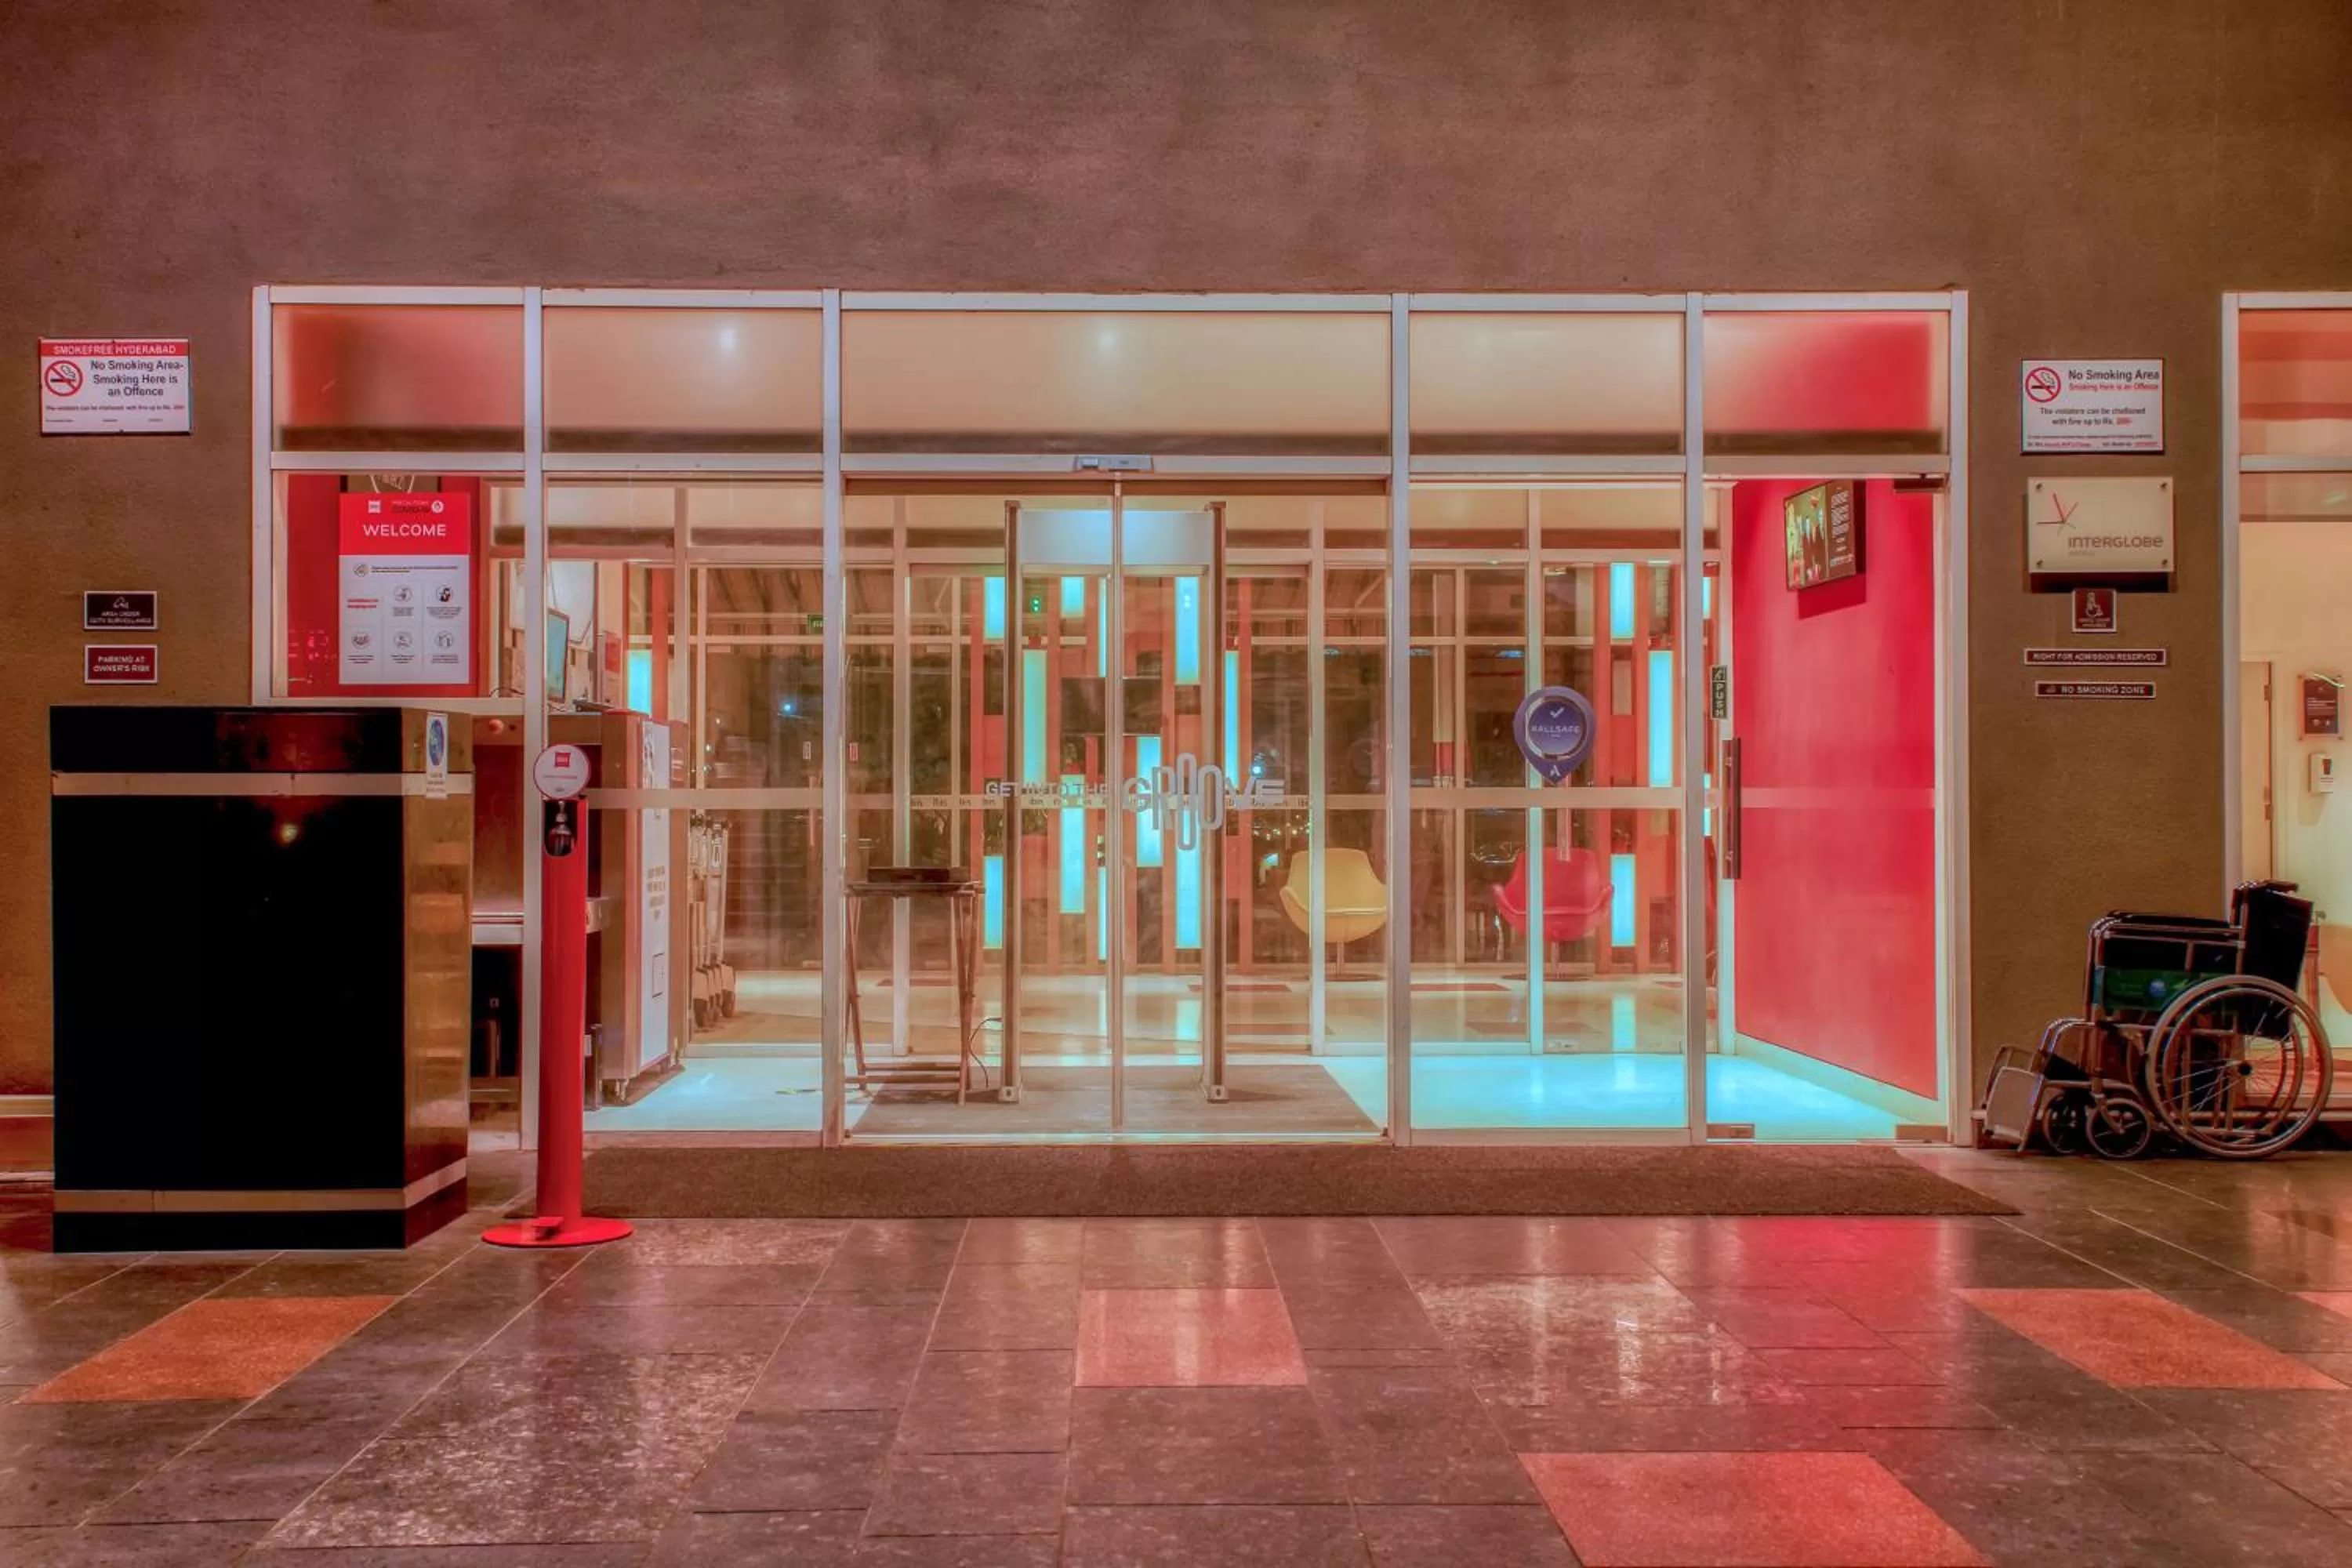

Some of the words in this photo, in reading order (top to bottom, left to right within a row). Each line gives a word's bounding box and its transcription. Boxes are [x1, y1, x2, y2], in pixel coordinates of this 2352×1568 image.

[53, 345, 114, 355] SMOKEFREE
[115, 345, 176, 354] HYDERABAD
[90, 361, 106, 371] No
[108, 360, 154, 372] Smoking
[93, 374, 139, 386] Smoking
[141, 374, 165, 383] Here
[169, 374, 179, 383] is
[2068, 370, 2082, 380] No
[2085, 369, 2132, 382] Smoking
[2134, 369, 2159, 380] Area
[123, 385, 164, 396] Offence
[362, 523, 447, 536] WELCOME
[2060, 685, 2074, 694] NO
[2076, 685, 2119, 694] SMOKING
[2120, 685, 2146, 694] ZONE
[1715, 683, 1725, 717] PUSH
[986, 781, 1018, 797] GET
[1122, 752, 1287, 851] GROOVE
